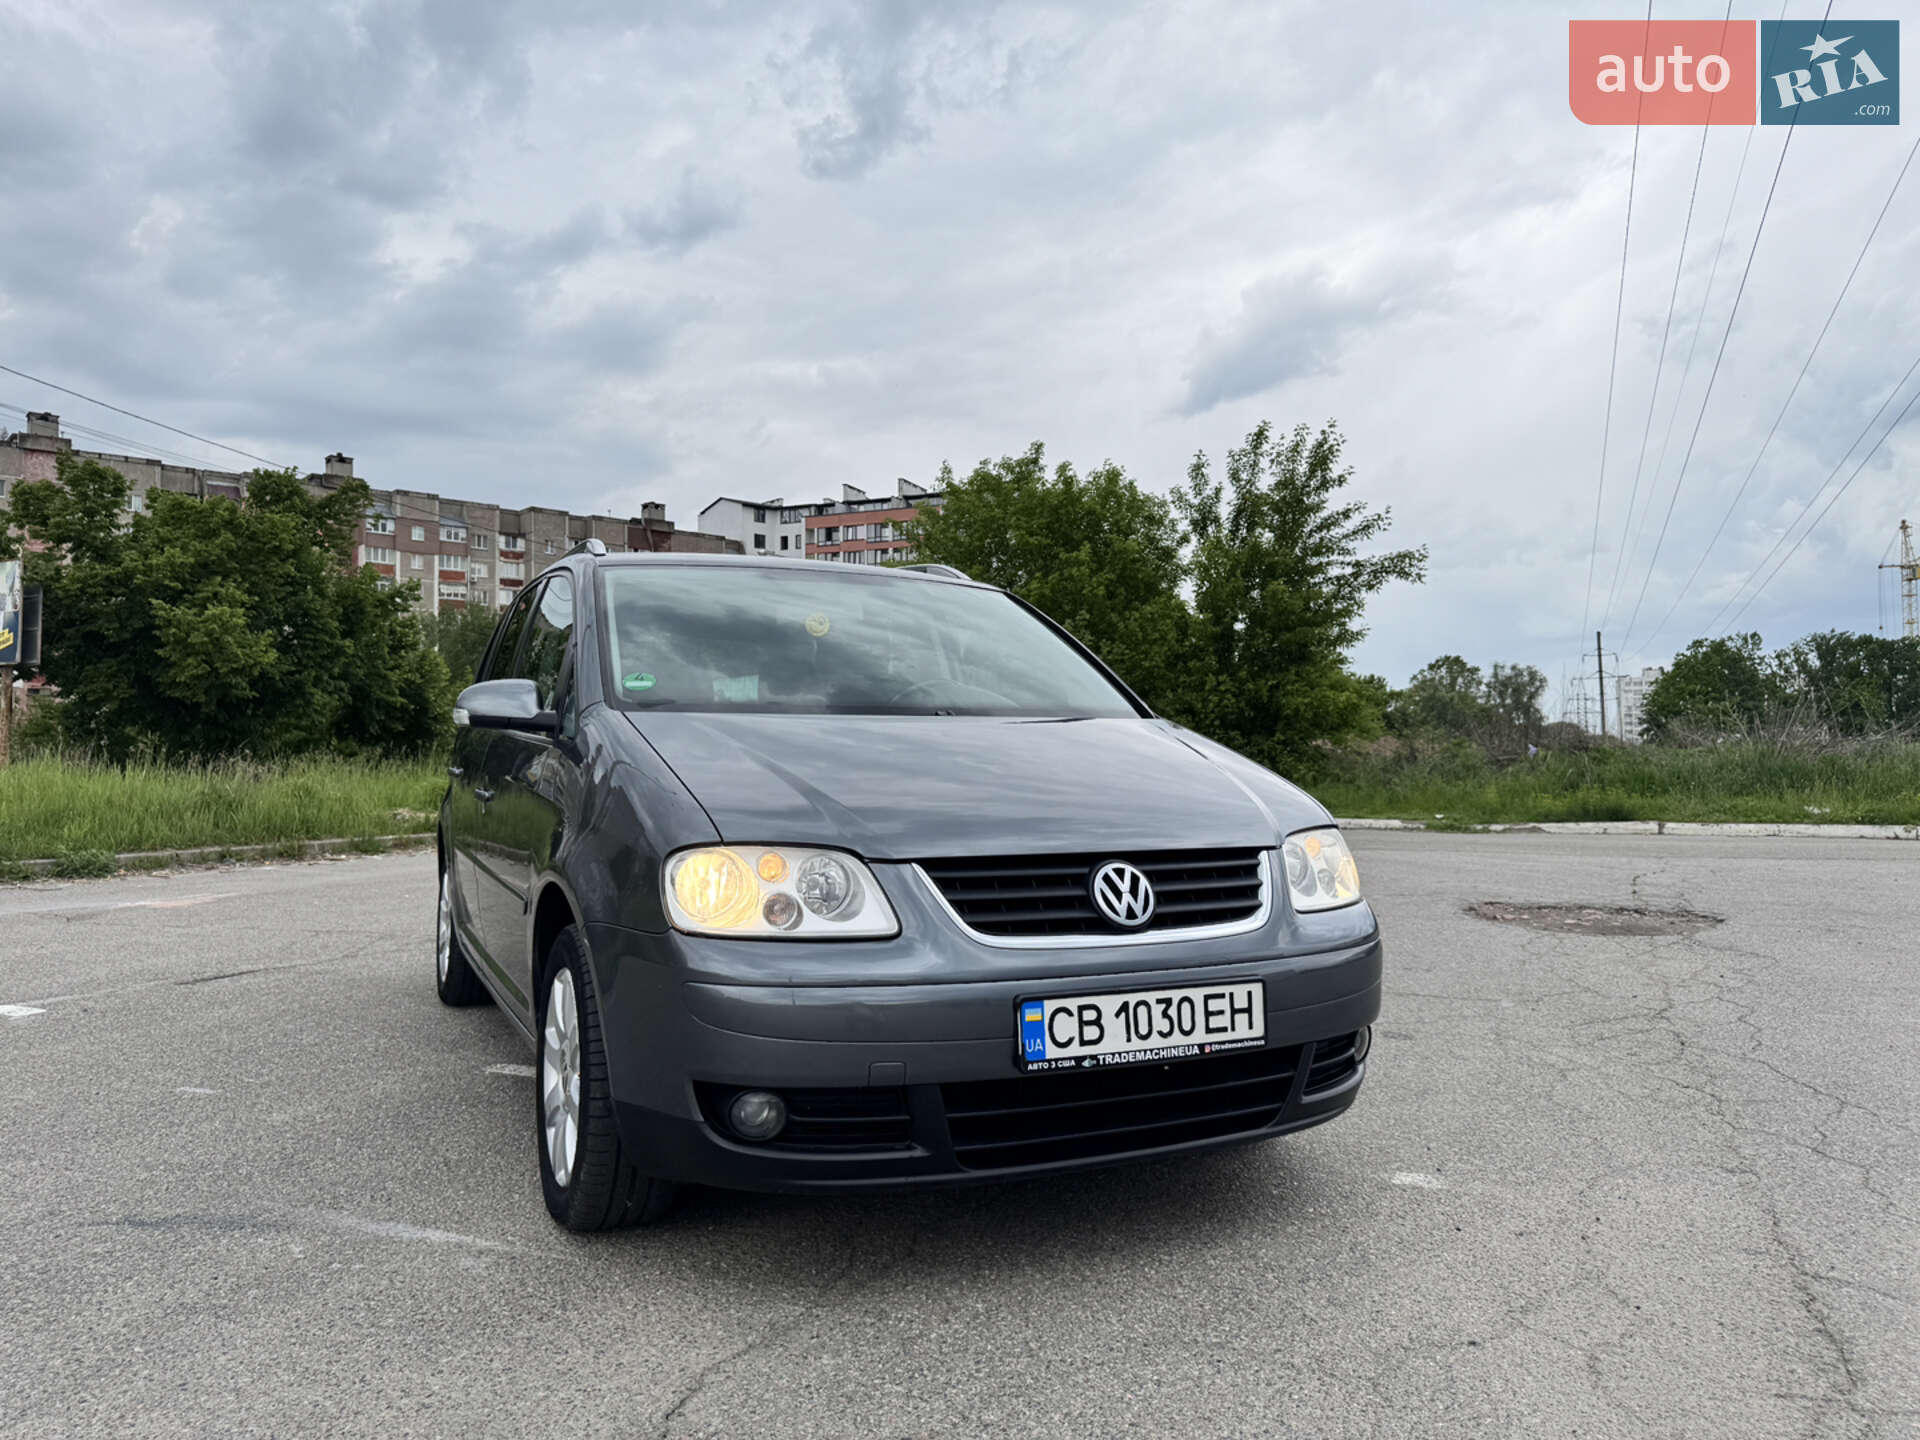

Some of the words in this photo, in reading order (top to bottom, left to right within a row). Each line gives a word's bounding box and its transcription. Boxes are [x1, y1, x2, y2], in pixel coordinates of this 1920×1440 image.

[1113, 995, 1196, 1043] 1030
[1025, 1039, 1044, 1053] UA
[1097, 1045, 1200, 1066] TRADEMACHINEUA
